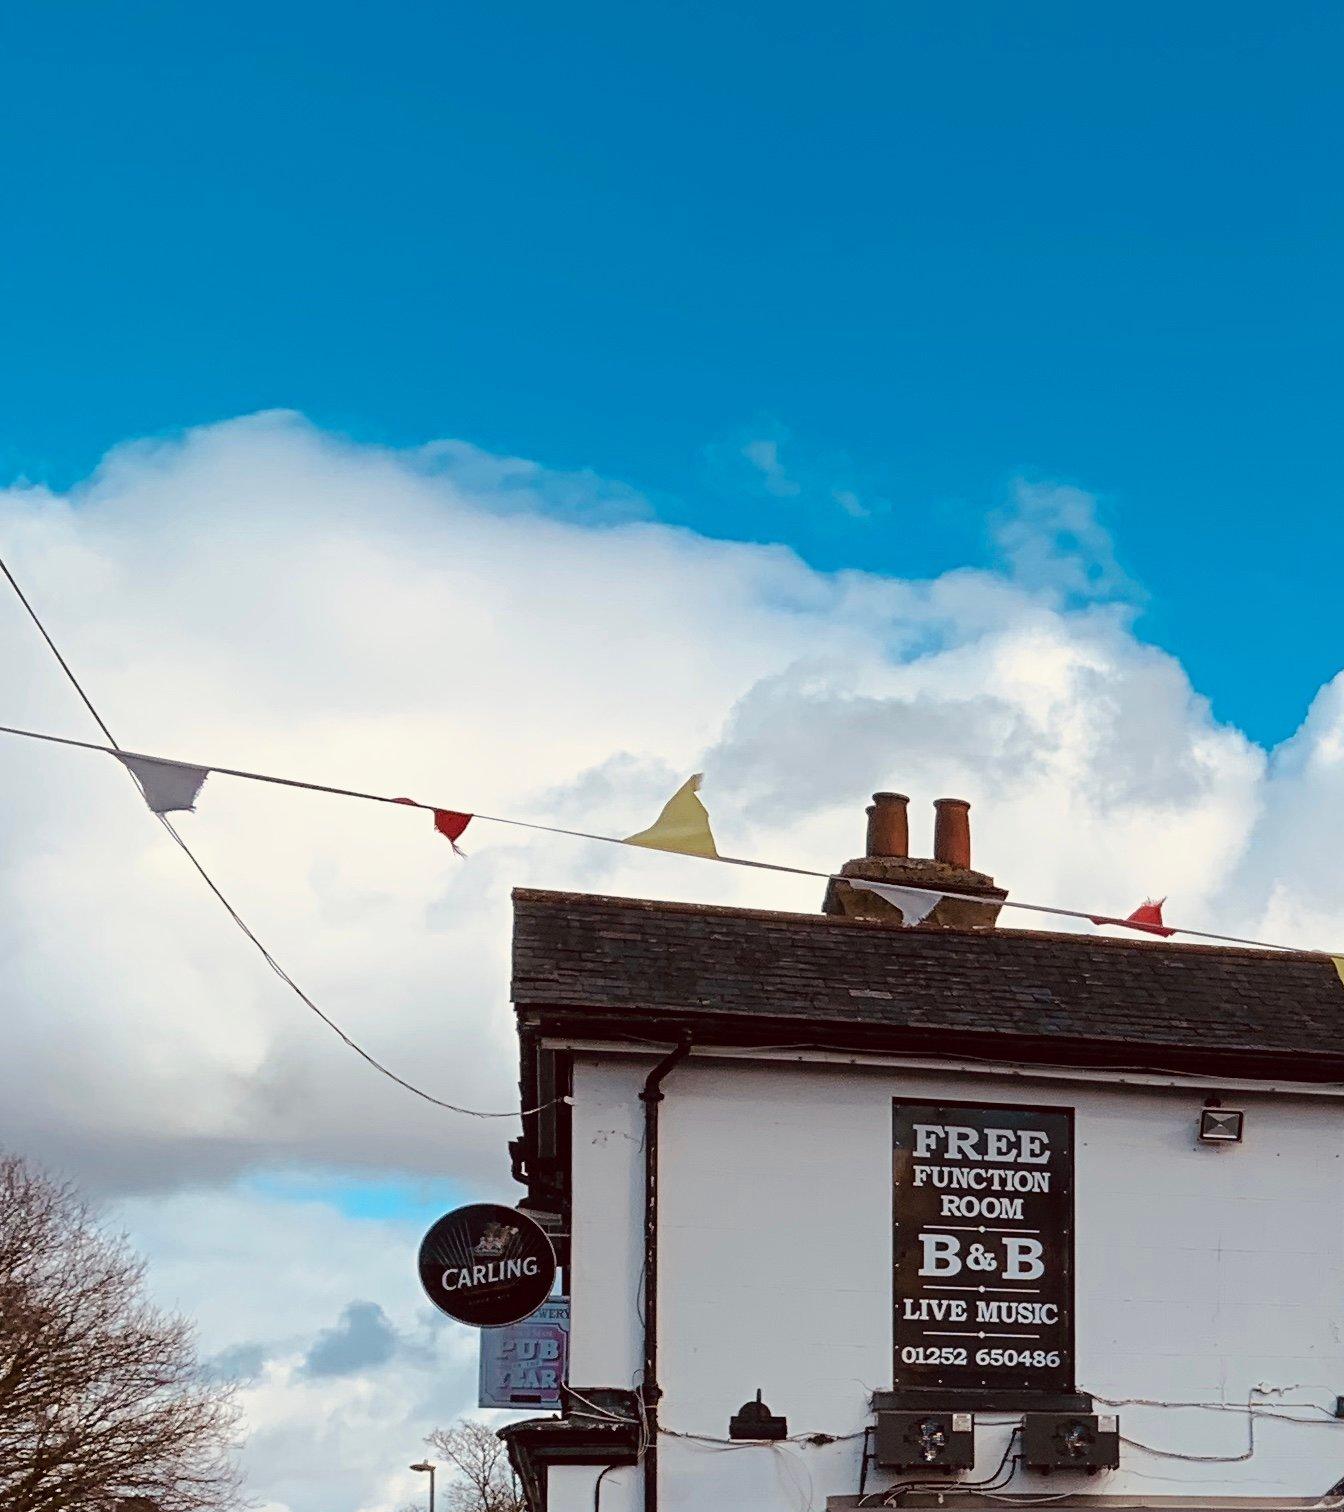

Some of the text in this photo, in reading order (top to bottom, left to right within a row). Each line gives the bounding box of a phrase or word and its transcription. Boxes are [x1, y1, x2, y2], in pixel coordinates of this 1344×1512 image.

[912, 1124, 1051, 1164] FREE
[912, 1165, 1051, 1193] FUNCTION
[940, 1195, 1025, 1220] ROOM
[441, 1256, 538, 1291] CARLING
[902, 1298, 1059, 1325] LIVE MUSIC
[901, 1346, 1061, 1367] 01252 650486
